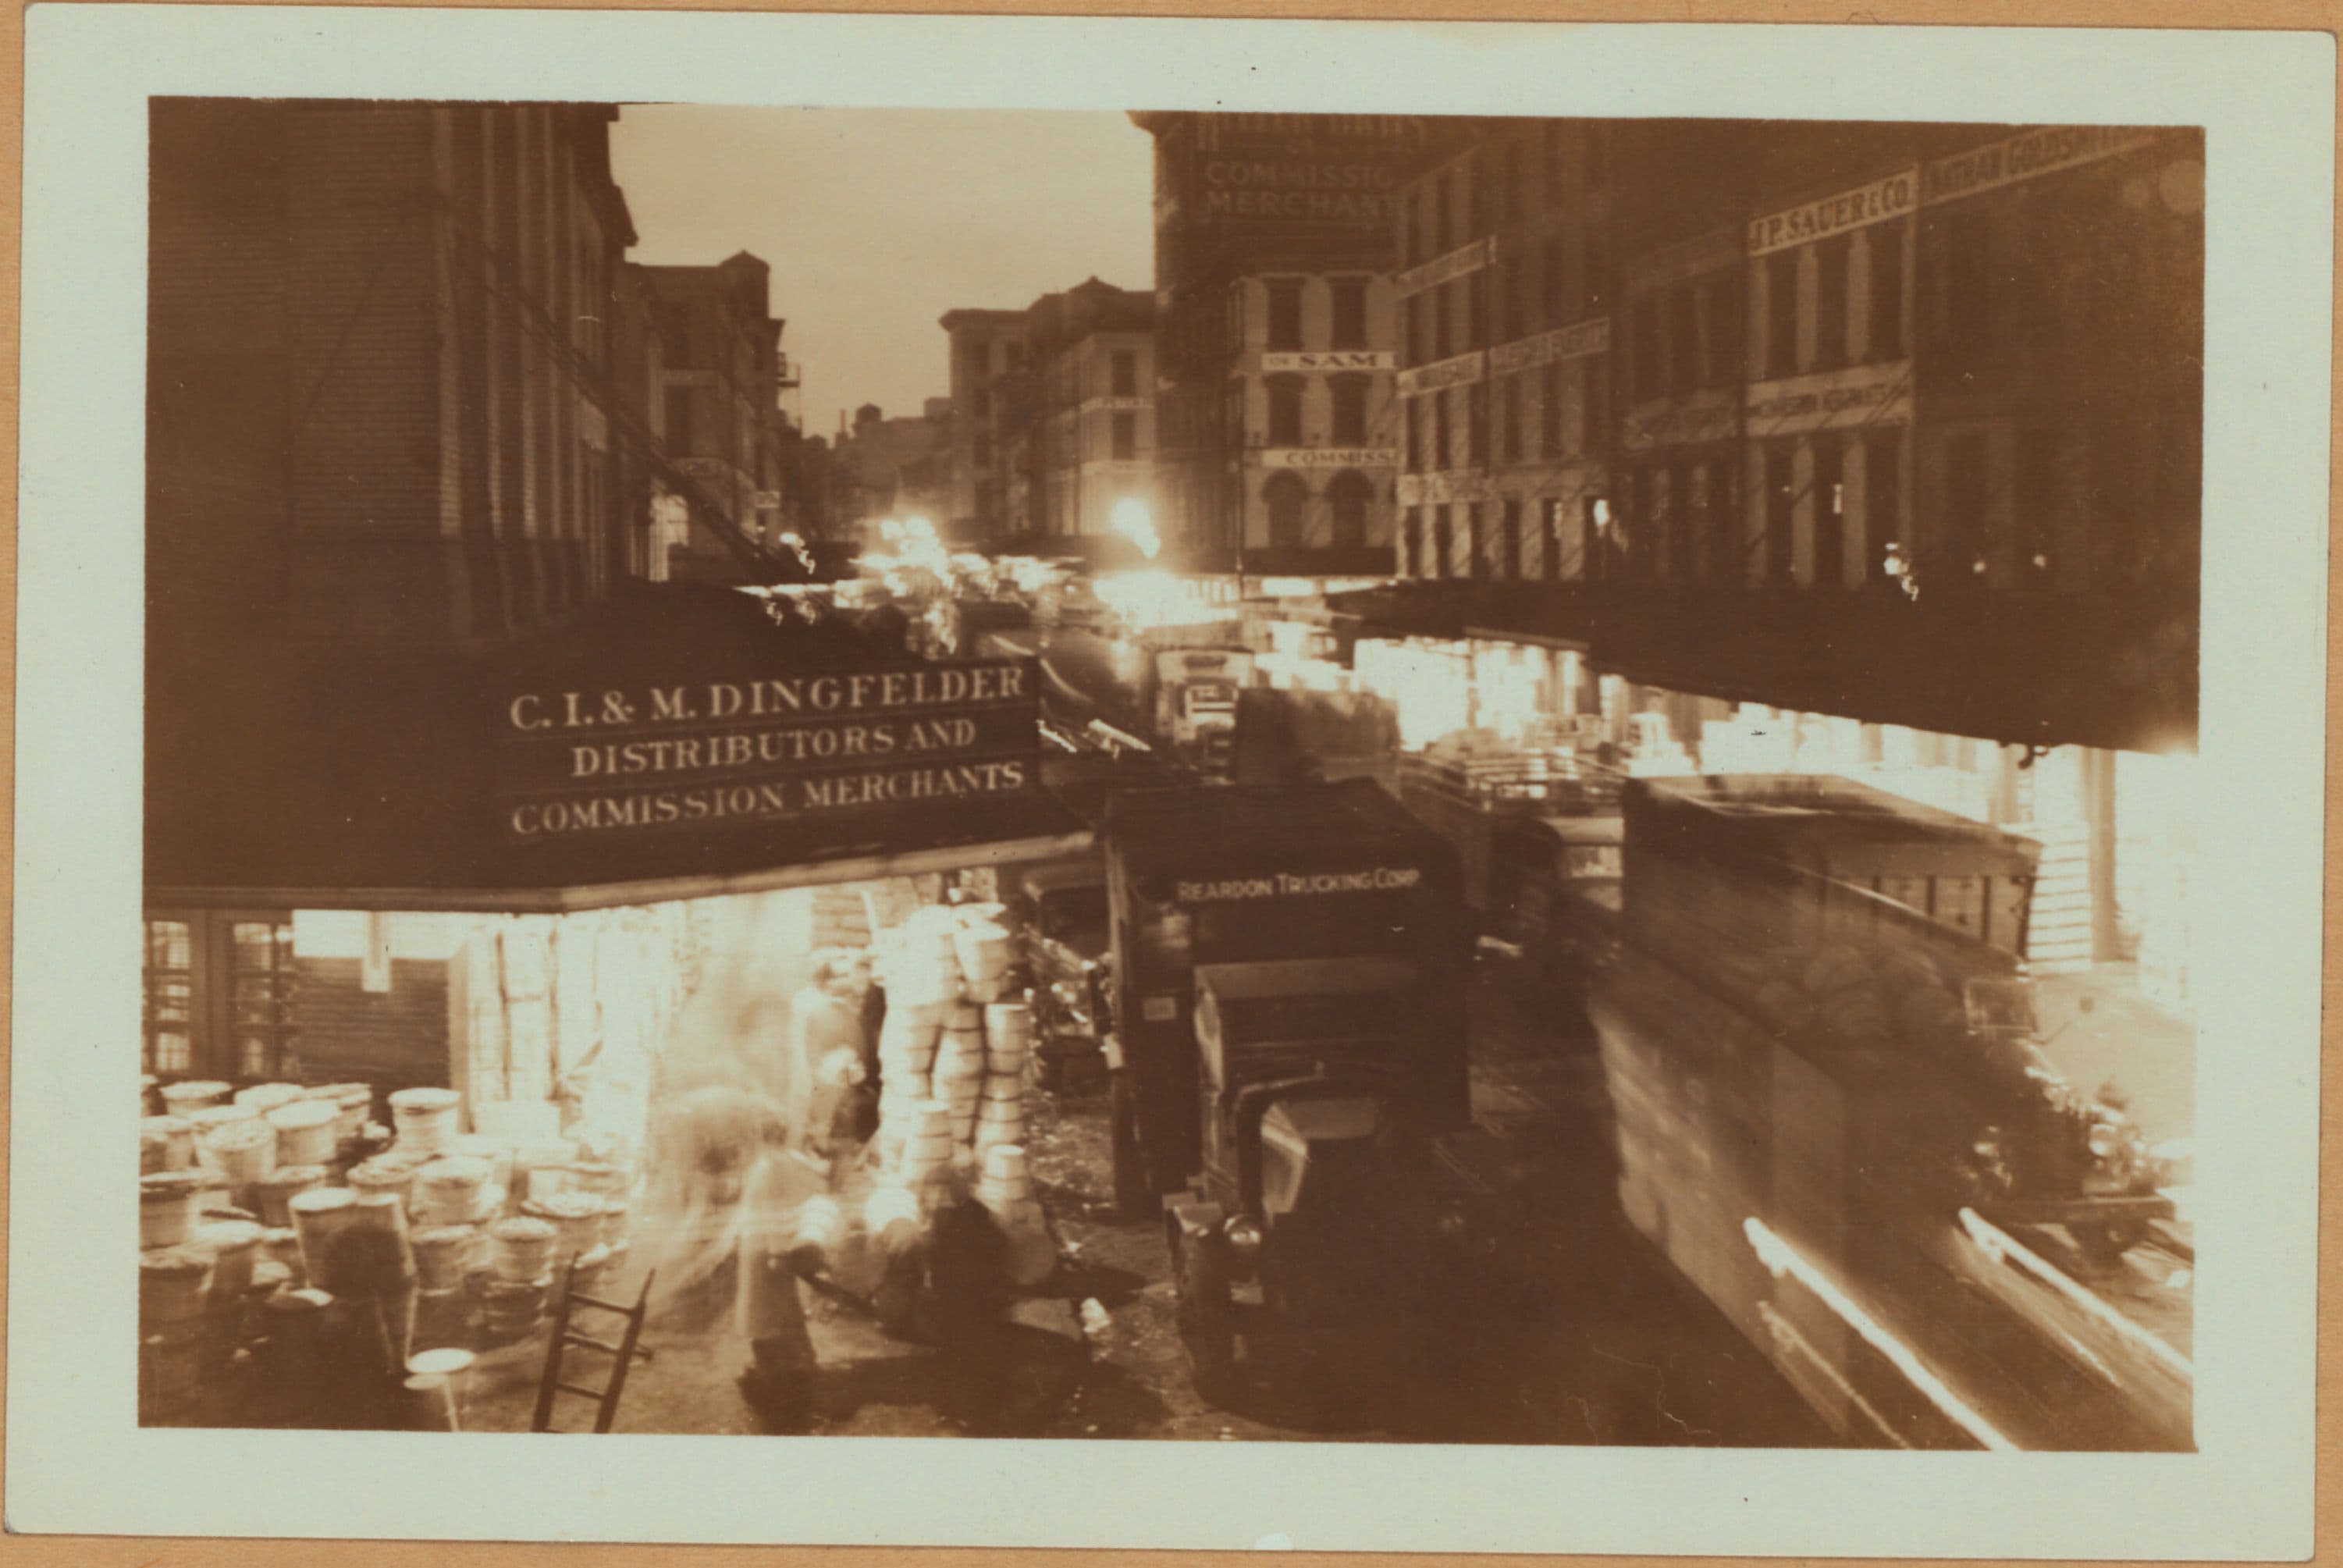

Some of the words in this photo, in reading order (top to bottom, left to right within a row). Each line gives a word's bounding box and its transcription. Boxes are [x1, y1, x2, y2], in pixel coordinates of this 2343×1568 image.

[1787, 193, 1865, 240] SAUER
[709, 666, 1025, 718] DINGFELDER
[571, 724, 896, 778] DISTRIBUTORS
[904, 717, 976, 752] AND
[512, 782, 784, 835] COMMISSION
[803, 760, 1024, 809] MERCHANTS
